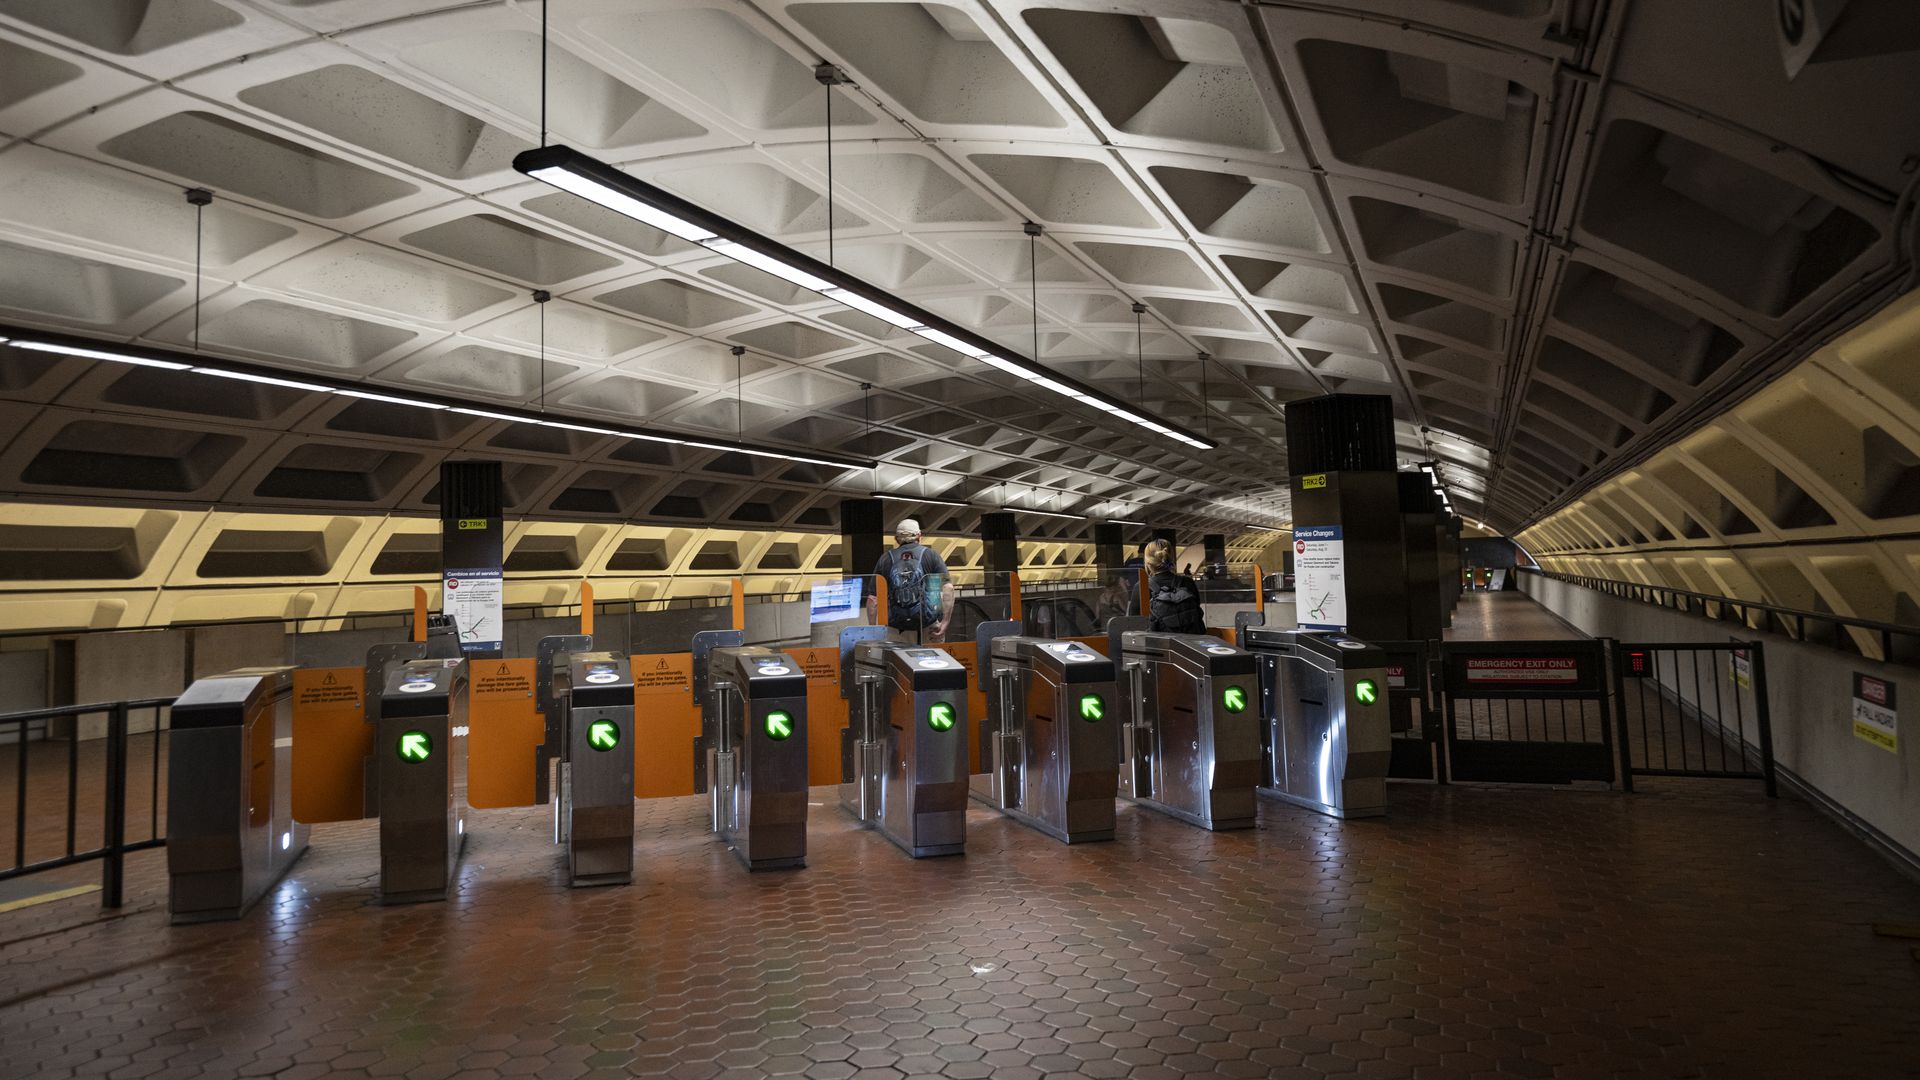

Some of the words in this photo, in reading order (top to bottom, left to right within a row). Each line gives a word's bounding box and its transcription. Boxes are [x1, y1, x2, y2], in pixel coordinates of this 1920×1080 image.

[1304, 479, 1318, 487] TRK2
[1469, 660, 1524, 668] EMERGENCY
[1526, 660, 1546, 668] EXIT
[1548, 660, 1574, 668] ONLY
[1386, 667, 1402, 675] NLY
